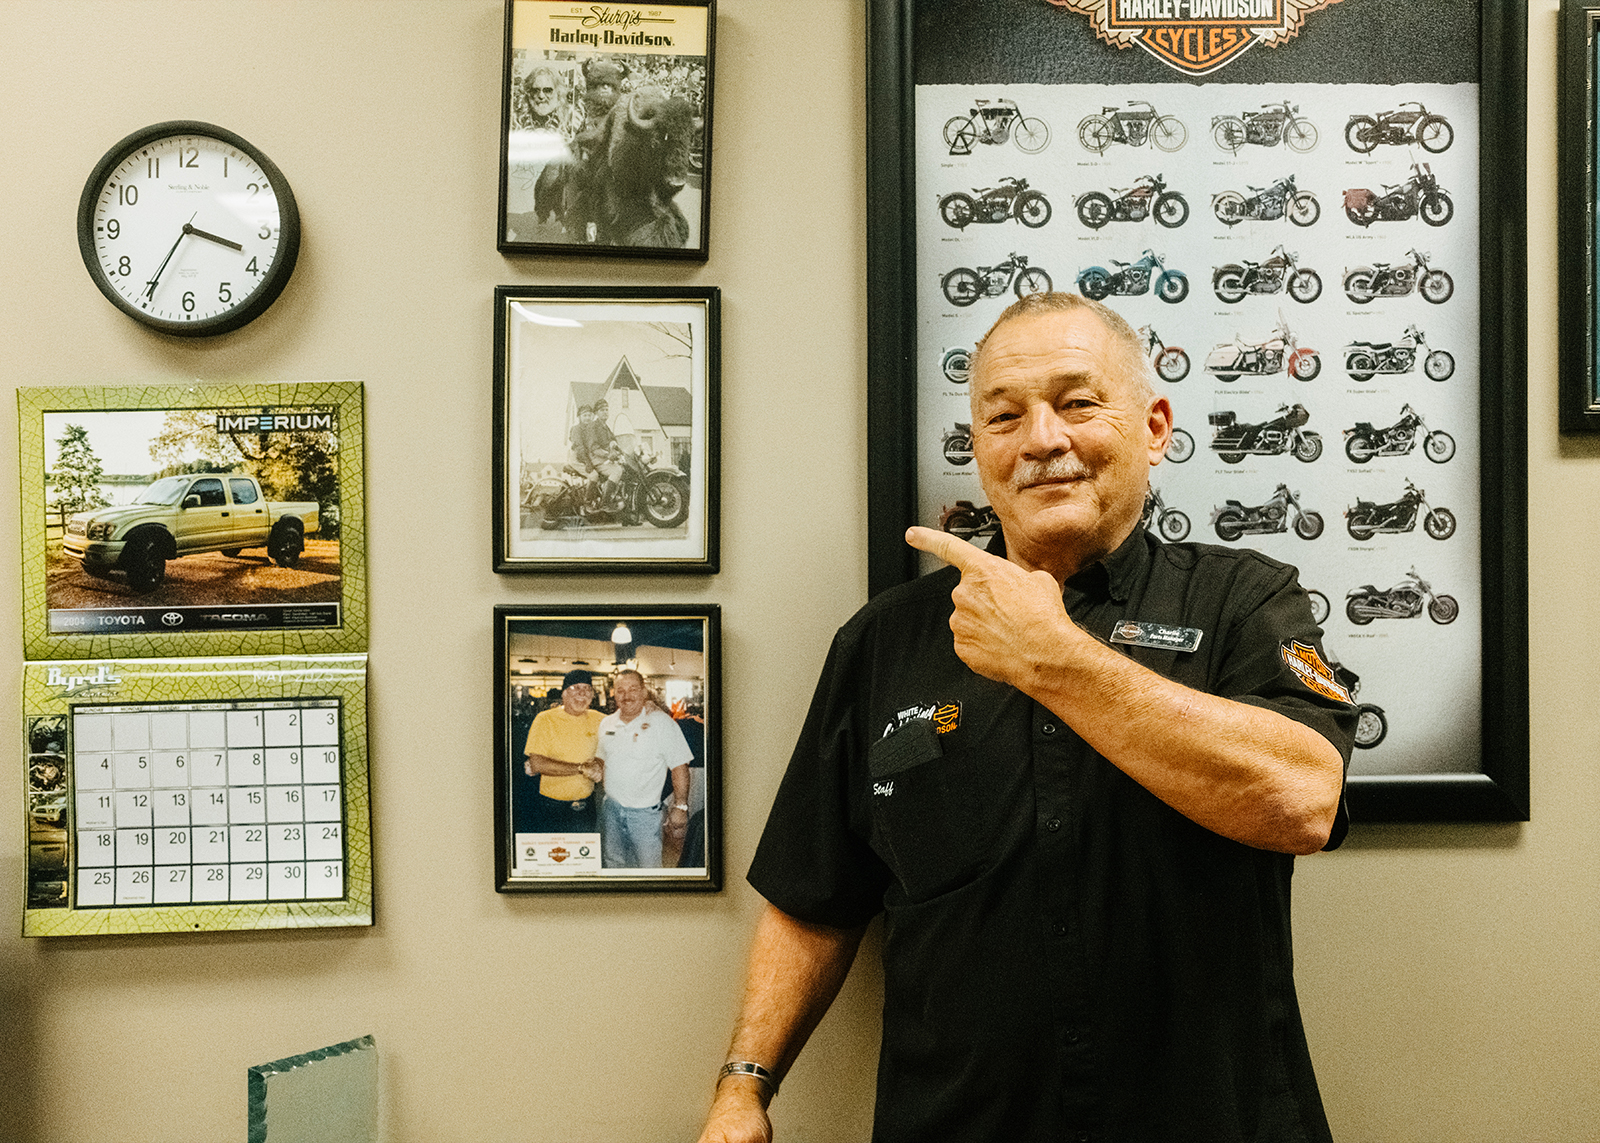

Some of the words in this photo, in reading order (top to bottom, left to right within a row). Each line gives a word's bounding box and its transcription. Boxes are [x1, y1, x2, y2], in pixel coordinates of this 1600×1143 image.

[581, 6, 641, 32] Sturgis
[1119, 0, 1273, 18] HARLEY-DAVIDSON
[1154, 28, 1237, 61] CYCLES
[148, 157, 160, 178] 11
[178, 147, 199, 168] 12
[223, 157, 228, 178] 1
[118, 185, 139, 206] 10
[106, 219, 120, 240] 9
[257, 220, 271, 240] 3
[118, 256, 131, 276] 8
[245, 256, 259, 276] 4
[146, 281, 159, 302] 7
[181, 291, 195, 312] 6
[219, 282, 232, 303] 5
[219, 415, 331, 431] IMPERIUM
[98, 615, 145, 626] TOYOTA
[46, 664, 122, 692] Byrd's
[254, 715, 259, 727] 1
[289, 714, 297, 726] 2
[326, 712, 335, 726] 3
[897, 706, 920, 720] WHITE
[100, 758, 109, 770] 4
[138, 756, 147, 769] 5
[176, 755, 185, 768] 6
[214, 754, 222, 767] 7
[252, 753, 261, 766] 8
[290, 752, 299, 765] 9
[322, 751, 337, 764] 10
[98, 795, 110, 808] 11
[133, 794, 148, 807] 12
[172, 793, 186, 806] 13
[210, 793, 224, 805] 14
[247, 791, 262, 804] 15
[285, 790, 300, 803] 16
[323, 789, 336, 802] 17
[873, 782, 894, 796] Staff
[97, 833, 111, 847] 18
[135, 832, 149, 846] 19
[169, 831, 187, 844] 20
[209, 830, 225, 843] 21
[245, 829, 262, 842] 22
[284, 828, 301, 841] 23
[322, 827, 338, 840] 24
[93, 871, 112, 885] 25
[132, 870, 150, 884] 26
[169, 869, 187, 883] 27
[207, 868, 224, 881] 28
[246, 867, 263, 880] 29
[284, 865, 301, 879] 30
[323, 865, 339, 878] 31
